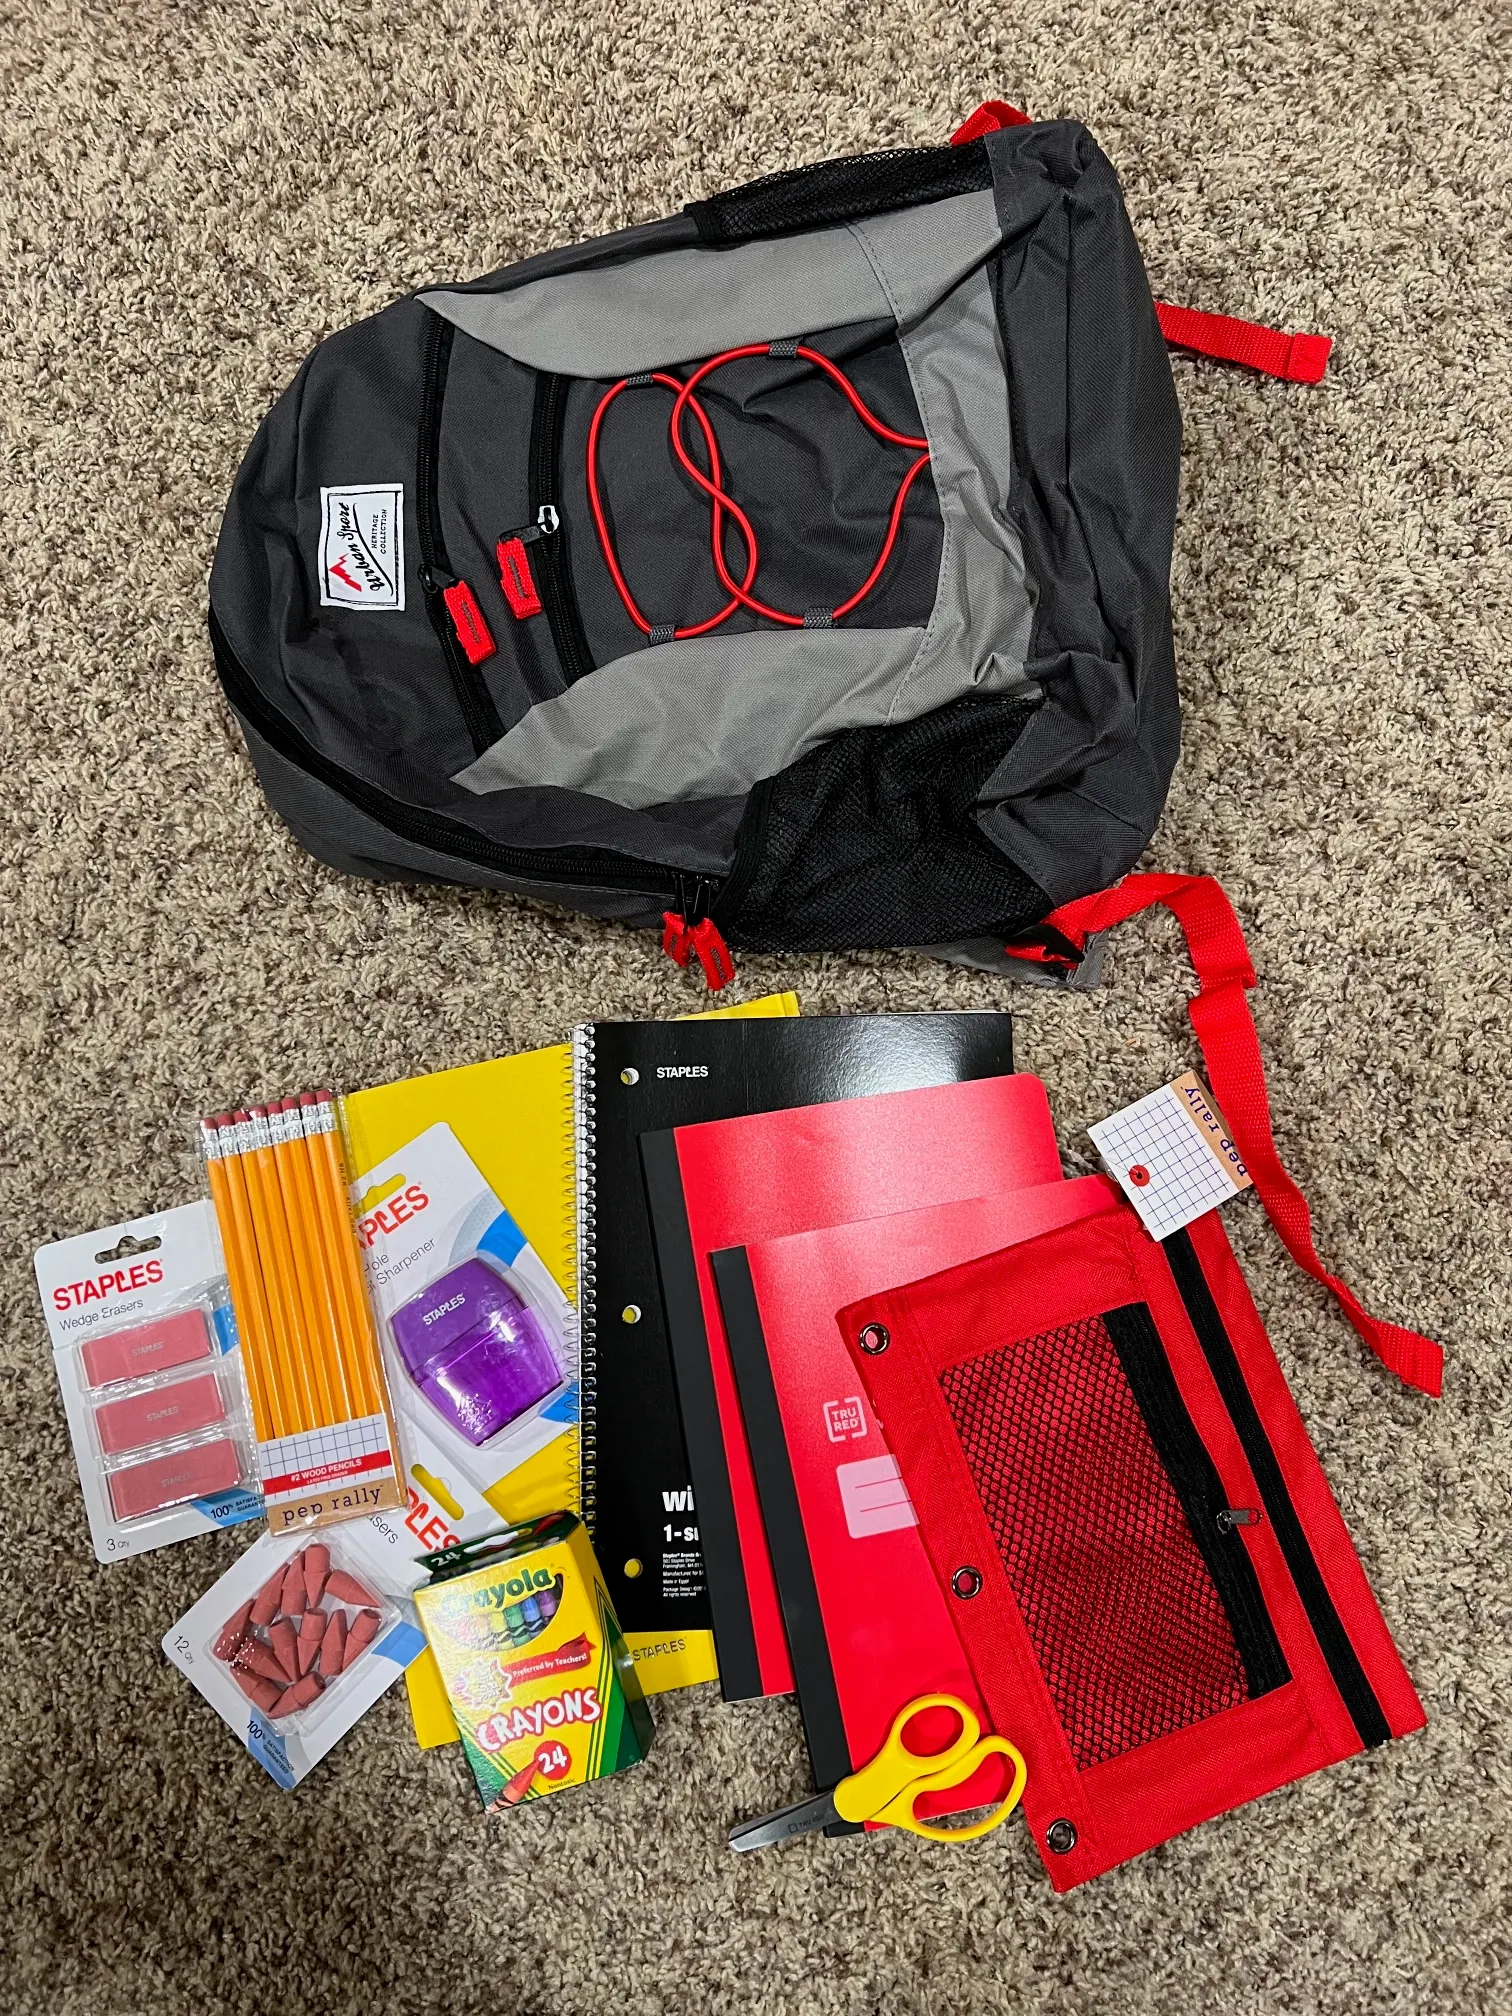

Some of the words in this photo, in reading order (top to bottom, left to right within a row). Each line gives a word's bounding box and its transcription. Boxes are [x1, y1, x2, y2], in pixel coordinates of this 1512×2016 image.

[337, 502, 358, 540] Sport
[371, 514, 379, 549] HERITAGE
[348, 543, 385, 591] Urban
[656, 1065, 708, 1079] STAPLES
[1185, 1086, 1219, 1133] rally
[1220, 1138, 1248, 1177] pep
[358, 1184, 429, 1250] PLES
[376, 1238, 436, 1285] Sharpener
[53, 1259, 164, 1311] STAPLES
[59, 1310, 99, 1331] Wedge
[101, 1299, 144, 1319] Erasers
[422, 1292, 466, 1326] STAPLES
[132, 1341, 165, 1357] STAPLES
[146, 1406, 179, 1422] STAPLES
[831, 1406, 857, 1421] TRU
[833, 1418, 858, 1432] RED
[290, 1475, 301, 1483] #2
[301, 1467, 327, 1480] WOOD
[328, 1458, 362, 1474] PENCILS
[210, 1503, 234, 1519] 100%
[282, 1502, 323, 1526] pep
[331, 1487, 381, 1510] rally
[106, 1538, 116, 1551] 3
[430, 1551, 462, 1567] 24
[442, 1568, 552, 1617] Crayola
[173, 1635, 190, 1653] 12
[632, 1638, 687, 1662] STAPLES
[512, 1661, 545, 1678] Preferred
[545, 1659, 554, 1669] by
[554, 1652, 588, 1666] Teachers!
[246, 1719, 267, 1741] 100%
[476, 1687, 602, 1752] CRAYONS
[538, 1745, 568, 1774] 24
[547, 1777, 576, 1791] Nontoxic
